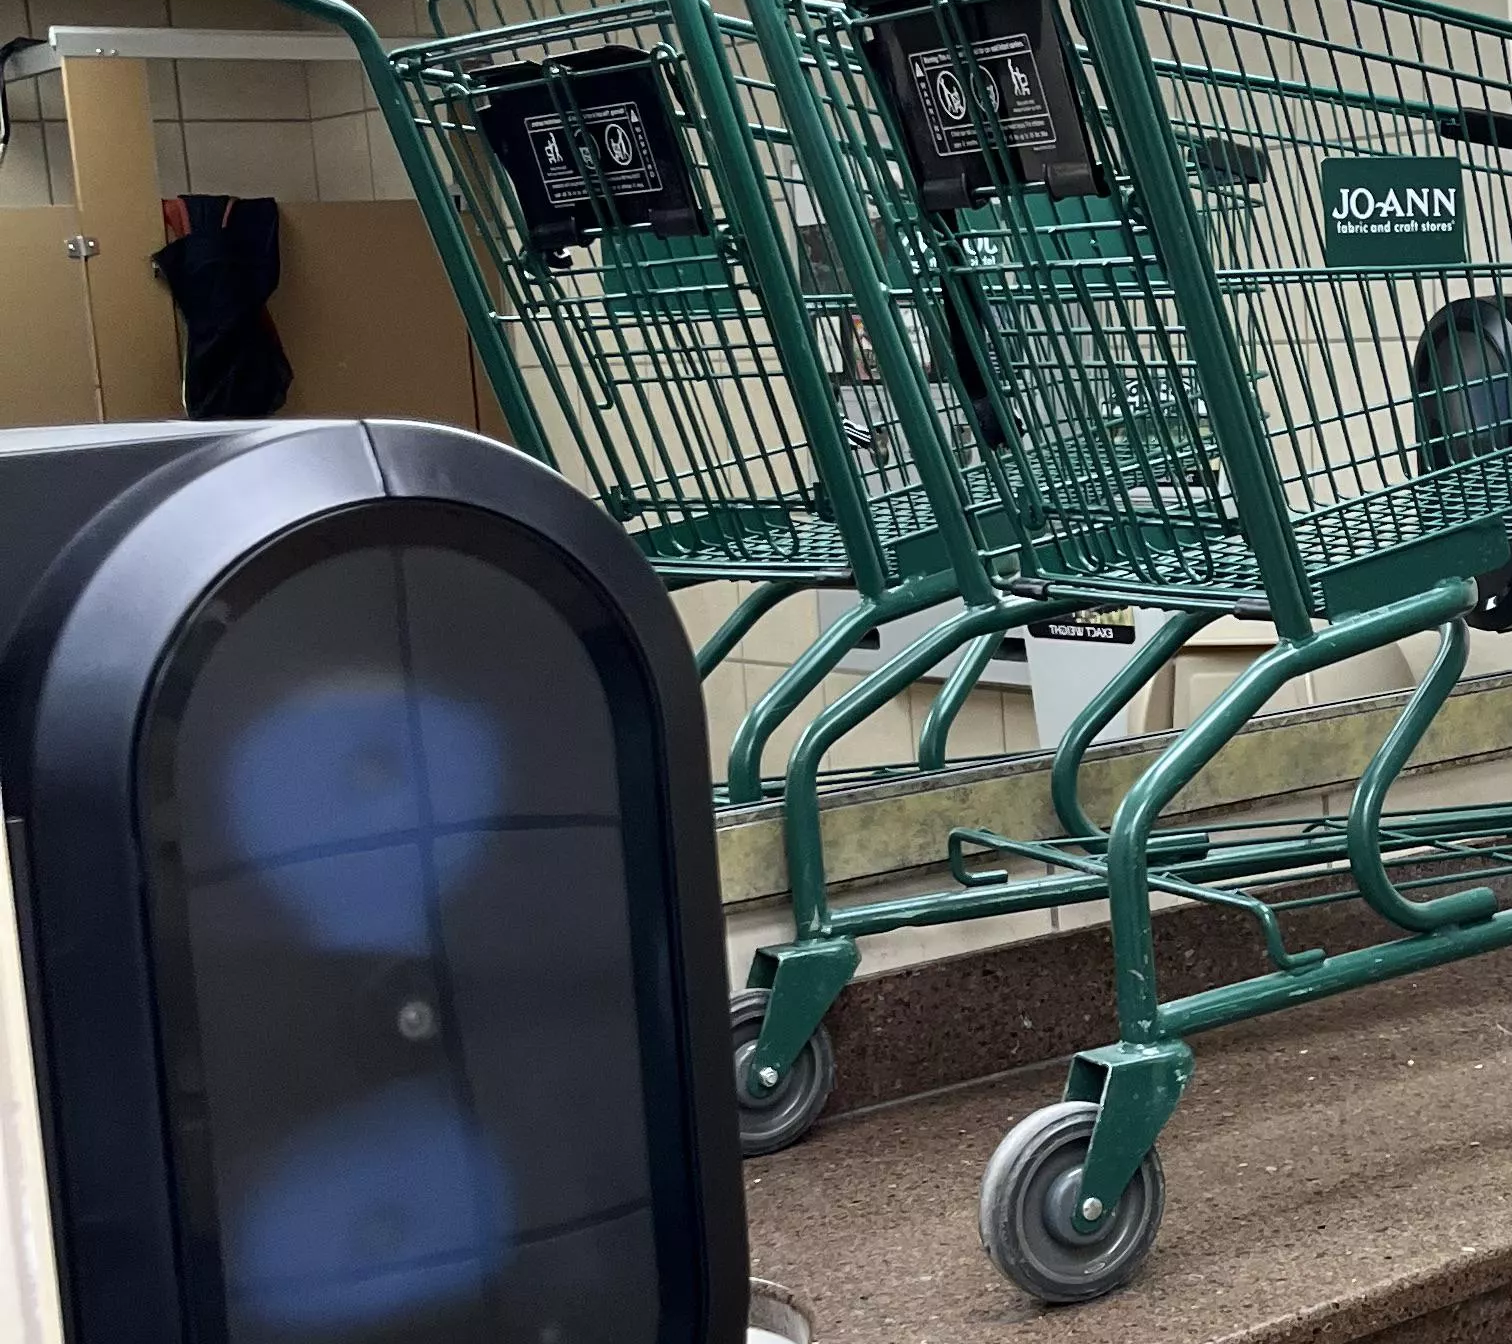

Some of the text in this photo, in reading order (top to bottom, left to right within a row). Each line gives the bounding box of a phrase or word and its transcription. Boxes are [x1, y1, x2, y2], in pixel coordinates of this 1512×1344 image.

[1336, 220, 1369, 234] fabric
[1370, 220, 1391, 233] and
[1394, 219, 1419, 233] craft
